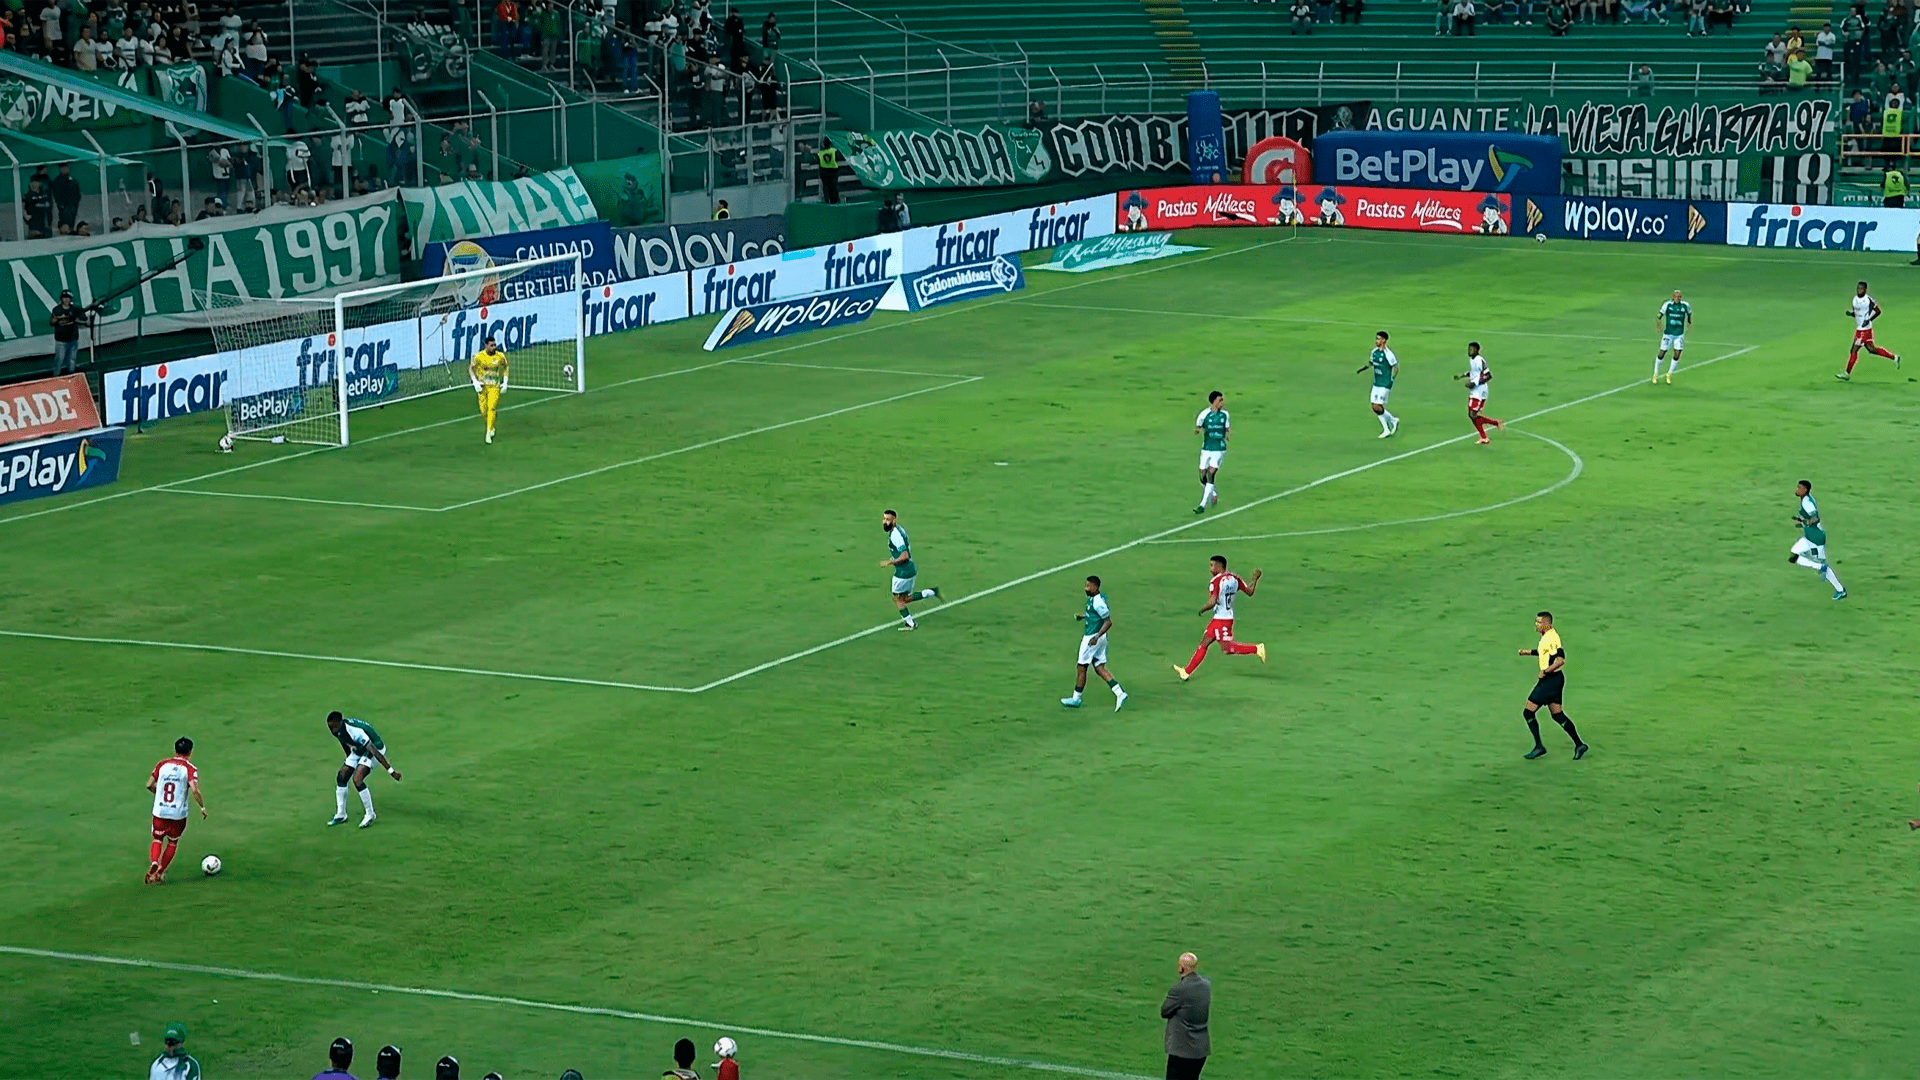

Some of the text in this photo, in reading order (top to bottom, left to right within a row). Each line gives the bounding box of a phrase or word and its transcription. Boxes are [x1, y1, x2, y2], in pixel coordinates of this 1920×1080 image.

[1365, 107, 1510, 132] AGUANTE
[1566, 100, 1648, 155] VIEJA
[1651, 102, 1790, 157] GUARDIA
[1794, 99, 1832, 151] 97
[1336, 148, 1485, 191] BetPlay
[1029, 205, 1090, 250] fricar
[1158, 200, 1198, 218] Pastas
[1357, 199, 1406, 219] Pastas
[1565, 200, 1668, 239] Wplay.co
[1746, 206, 1877, 250] fricar
[254, 205, 392, 300] 1997
[936, 222, 1000, 266] fricar
[824, 242, 892, 290] fricar
[704, 264, 776, 313] fricar
[754, 297, 877, 334] Wplay.co
[122, 363, 228, 425] fricar
[344, 375, 385, 397] etPlay
[240, 397, 289, 421] BetPlay
[163, 782, 176, 803] 8
